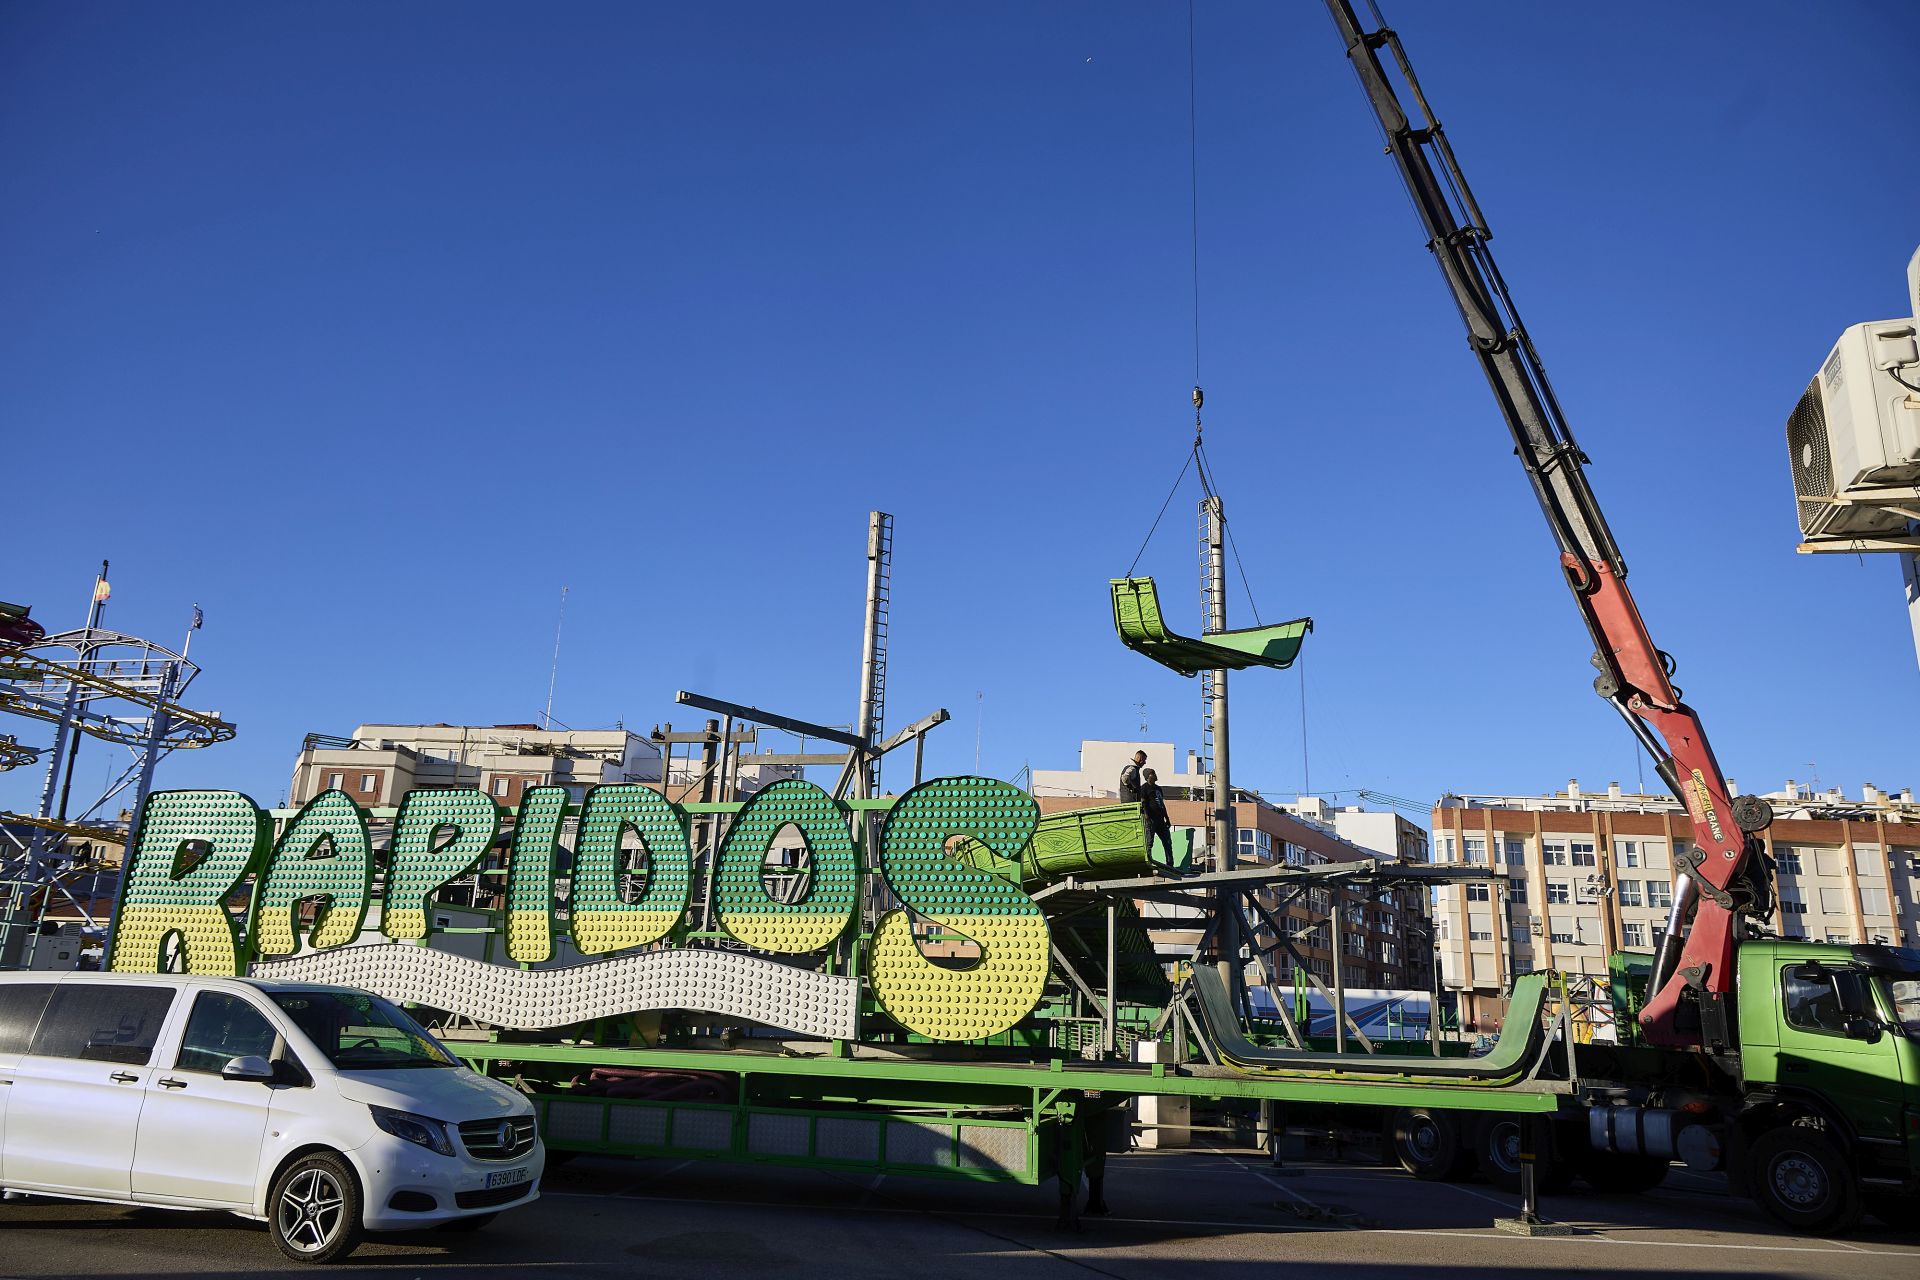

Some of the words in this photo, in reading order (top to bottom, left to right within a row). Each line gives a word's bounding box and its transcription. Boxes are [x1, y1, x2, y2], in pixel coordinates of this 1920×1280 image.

[1693, 771, 1712, 810] PAINGER
[1706, 810, 1722, 840] CRANE
[108, 775, 1052, 1040] RAPIDOS
[491, 1171, 512, 1187] 6390
